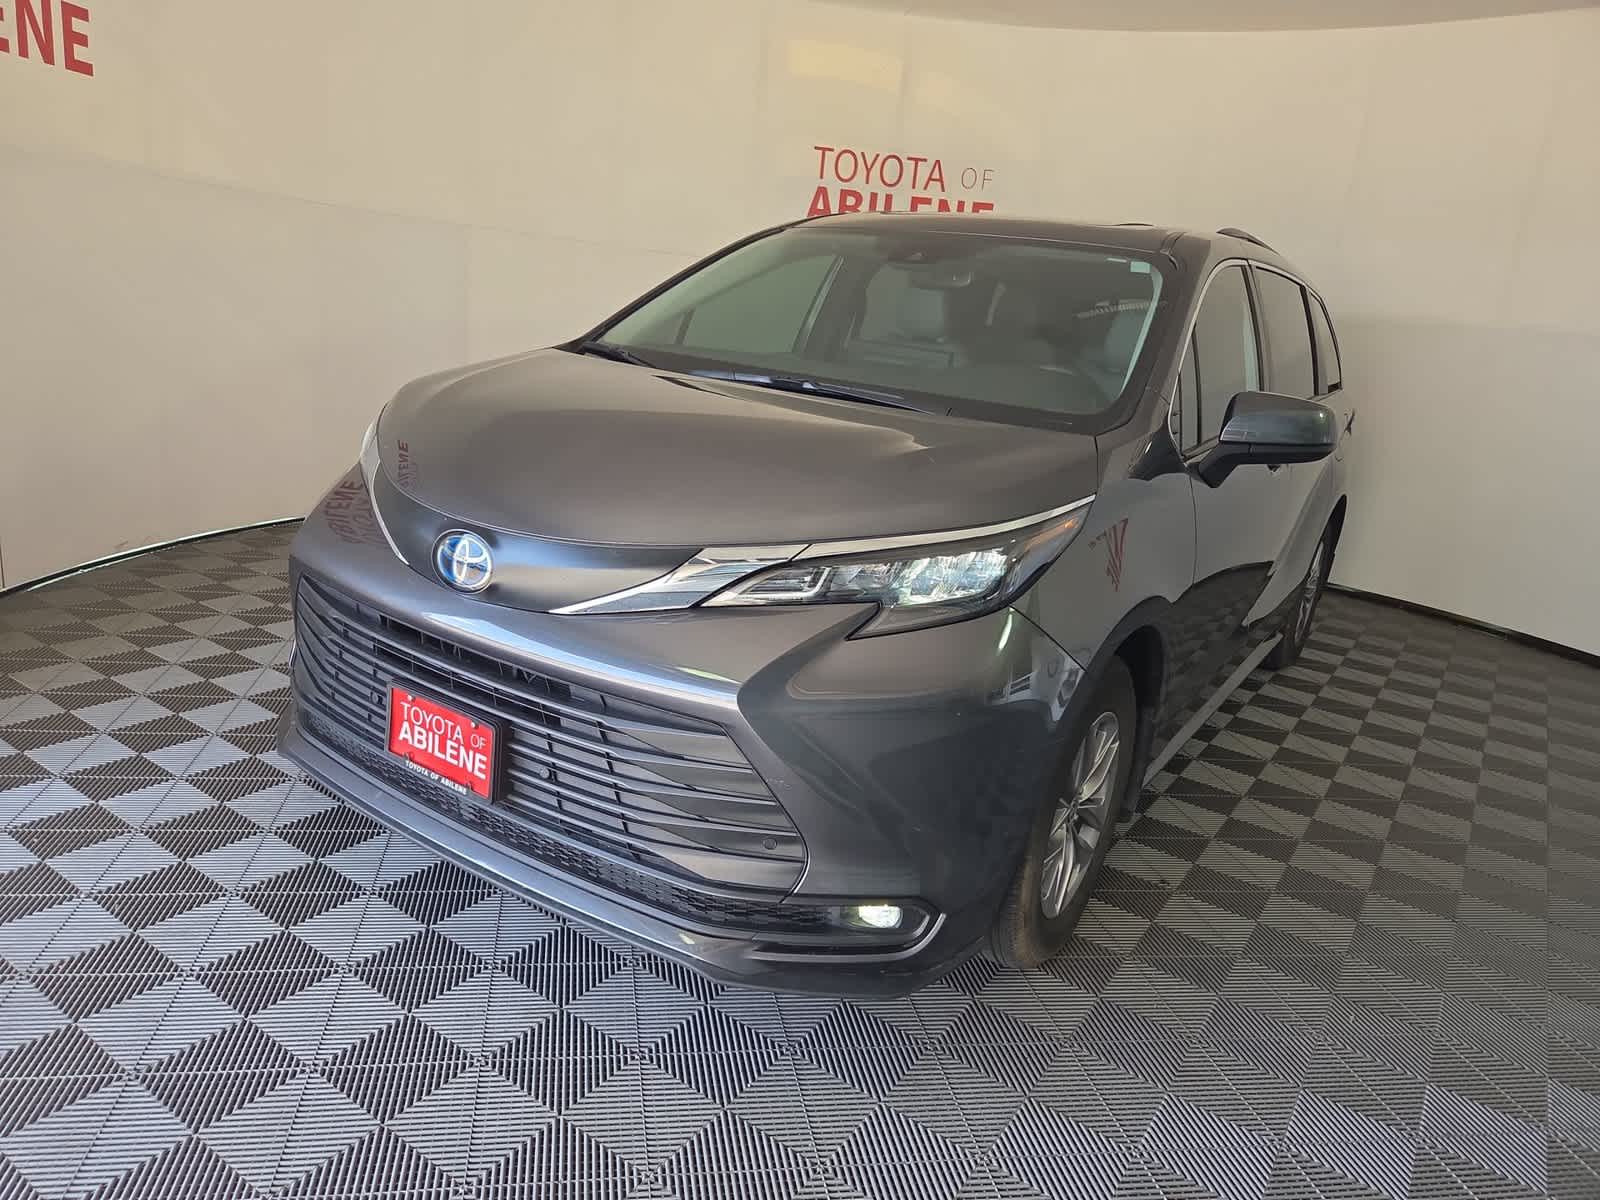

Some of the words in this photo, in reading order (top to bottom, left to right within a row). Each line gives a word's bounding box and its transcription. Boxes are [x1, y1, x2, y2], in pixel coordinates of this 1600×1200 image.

[814, 146, 946, 192] TOYOTA
[961, 167, 996, 192] OF
[400, 702, 464, 745] TOYOTA
[470, 733, 487, 749] OF
[398, 721, 488, 780] ABILENE
[405, 760, 428, 777] TOYOTA
[430, 771, 439, 780] OF
[440, 777, 467, 796] ABILENE
